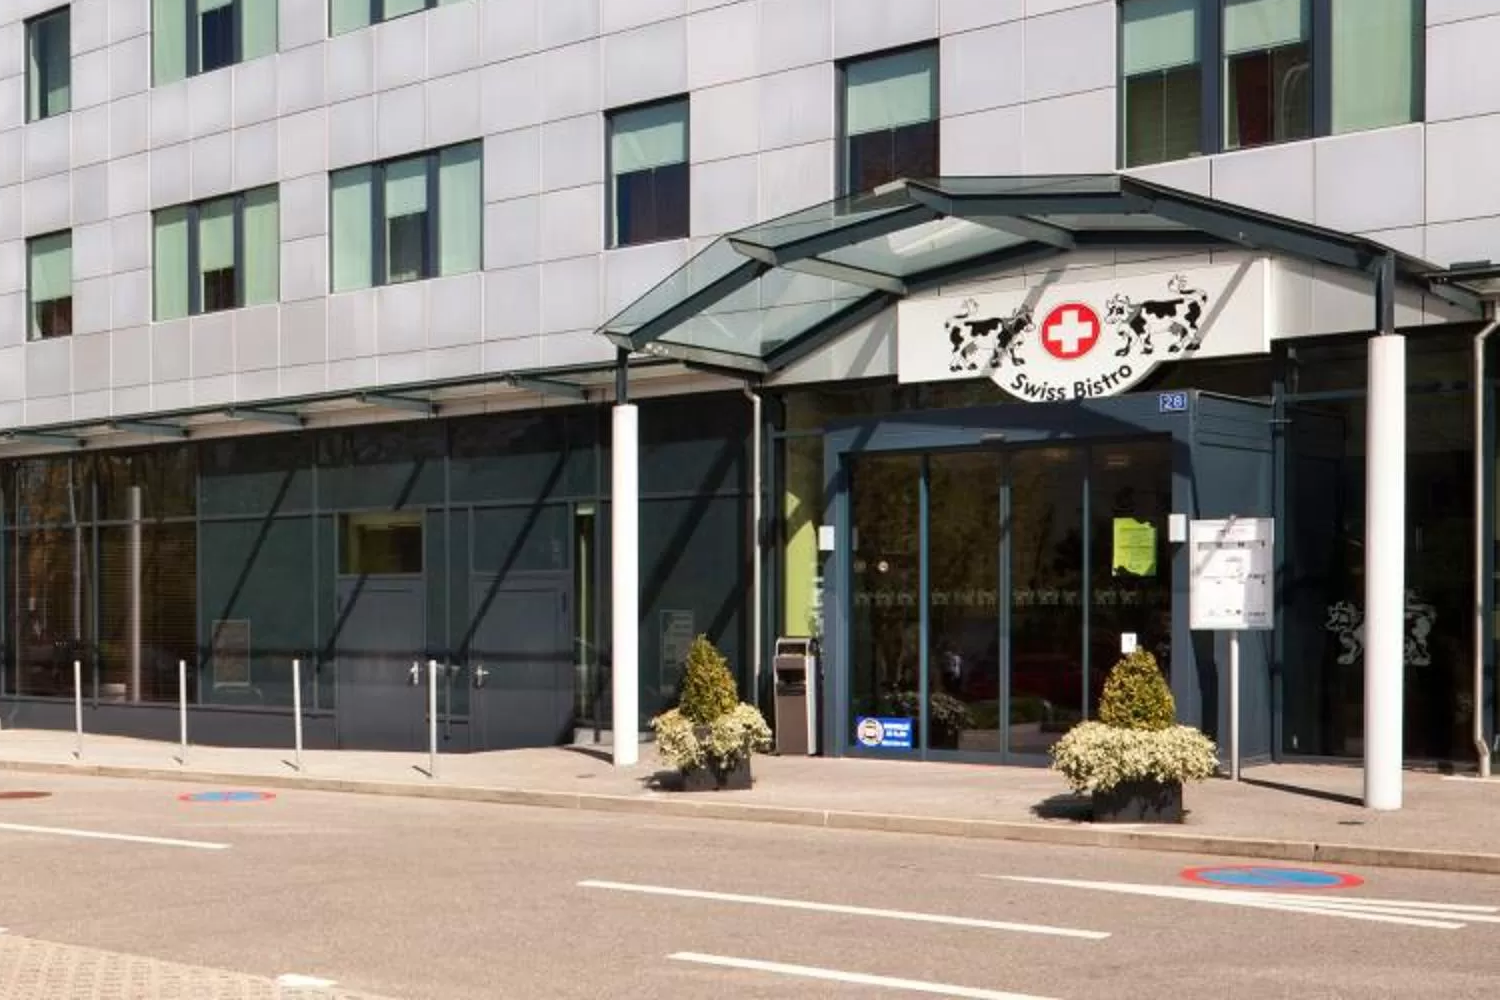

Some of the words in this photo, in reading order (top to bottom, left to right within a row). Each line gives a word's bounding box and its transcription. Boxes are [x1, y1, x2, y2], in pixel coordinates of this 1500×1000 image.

[1011, 373, 1066, 400] Swiss
[1073, 364, 1132, 398] Bistro
[1162, 395, 1183, 409] 28
